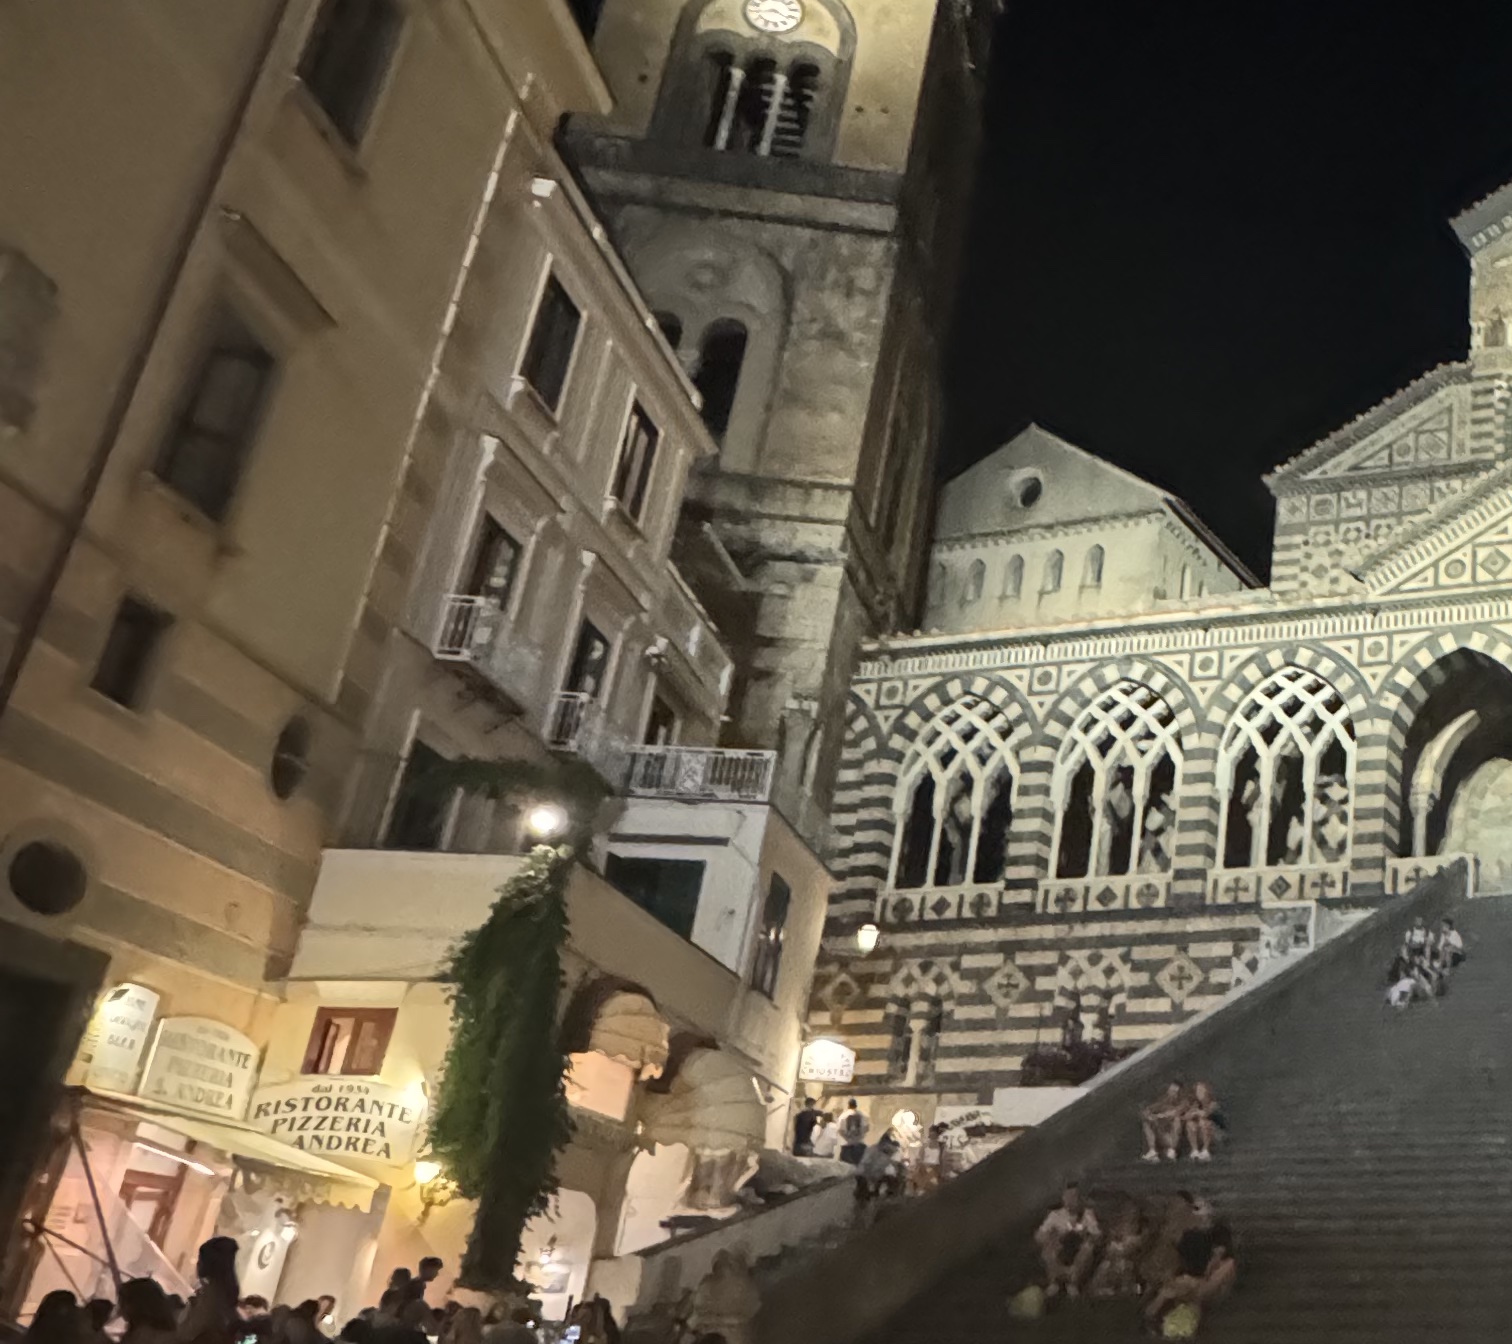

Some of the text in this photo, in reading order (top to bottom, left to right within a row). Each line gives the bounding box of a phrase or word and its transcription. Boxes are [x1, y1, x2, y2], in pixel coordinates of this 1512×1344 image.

[253, 1096, 412, 1124] RISTORANTE
[271, 1116, 386, 1138] PIZZERIA
[292, 1134, 391, 1159] ANDREA
